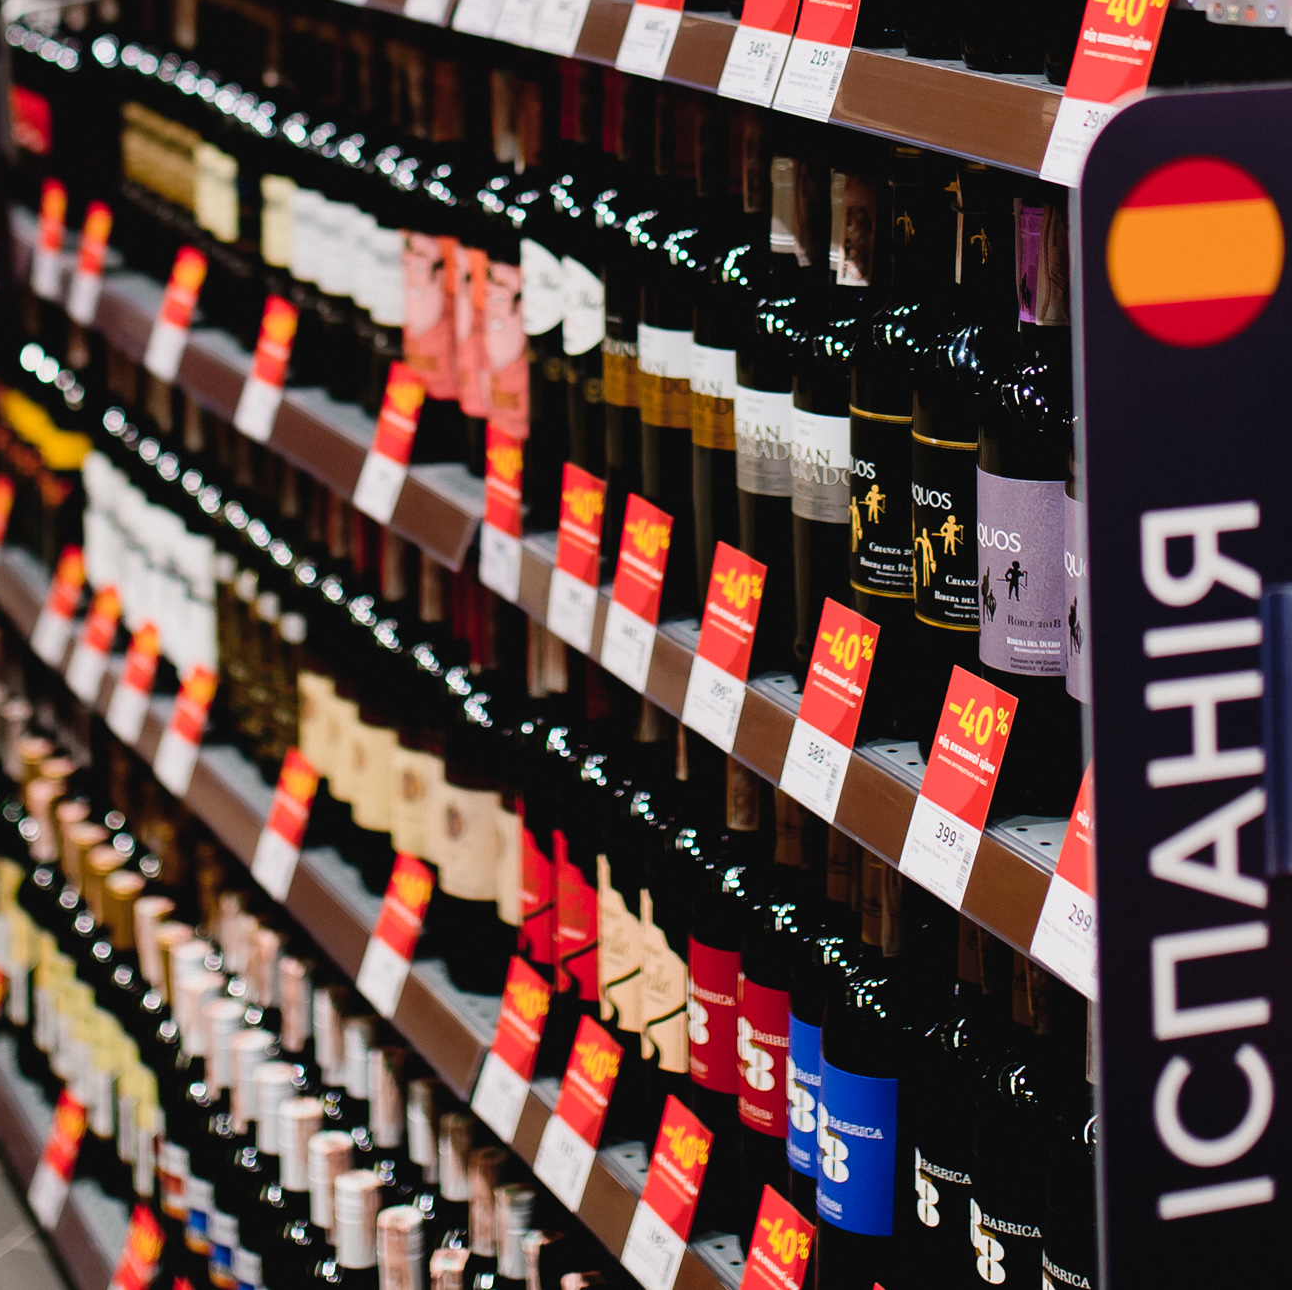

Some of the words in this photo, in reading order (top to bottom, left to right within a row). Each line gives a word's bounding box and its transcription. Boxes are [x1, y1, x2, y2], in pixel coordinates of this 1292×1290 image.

[810, 49, 829, 66] 219
[869, 542, 902, 555] CRIANZA
[977, 522, 1022, 553] QUOS
[860, 556, 881, 570] RIBERA
[713, 568, 763, 610] -40%
[934, 590, 960, 603] RIBERA
[1008, 614, 1035, 628] ROBLE
[1037, 619, 1062, 629] 2018
[820, 626, 875, 671] -40%
[1006, 636, 1026, 647] RIBERA
[1026, 639, 1039, 648] DEL
[1039, 640, 1061, 649] DUERO
[948, 698, 1010, 746] -40%
[938, 733, 950, 750] від
[949, 741, 981, 766] вказаної
[978, 757, 996, 776] ціни
[1076, 809, 1090, 830] від
[935, 821, 957, 847] 399
[1140, 501, 1276, 1221] ІСПАНІЯ
[1068, 903, 1093, 932] 299
[829, 1115, 884, 1140] BARRICA
[921, 1158, 972, 1185] BARRICA
[982, 1212, 1042, 1238] BARRICA
[759, 1217, 811, 1266] -40%
[1043, 1256, 1091, 1290] BARRICA
